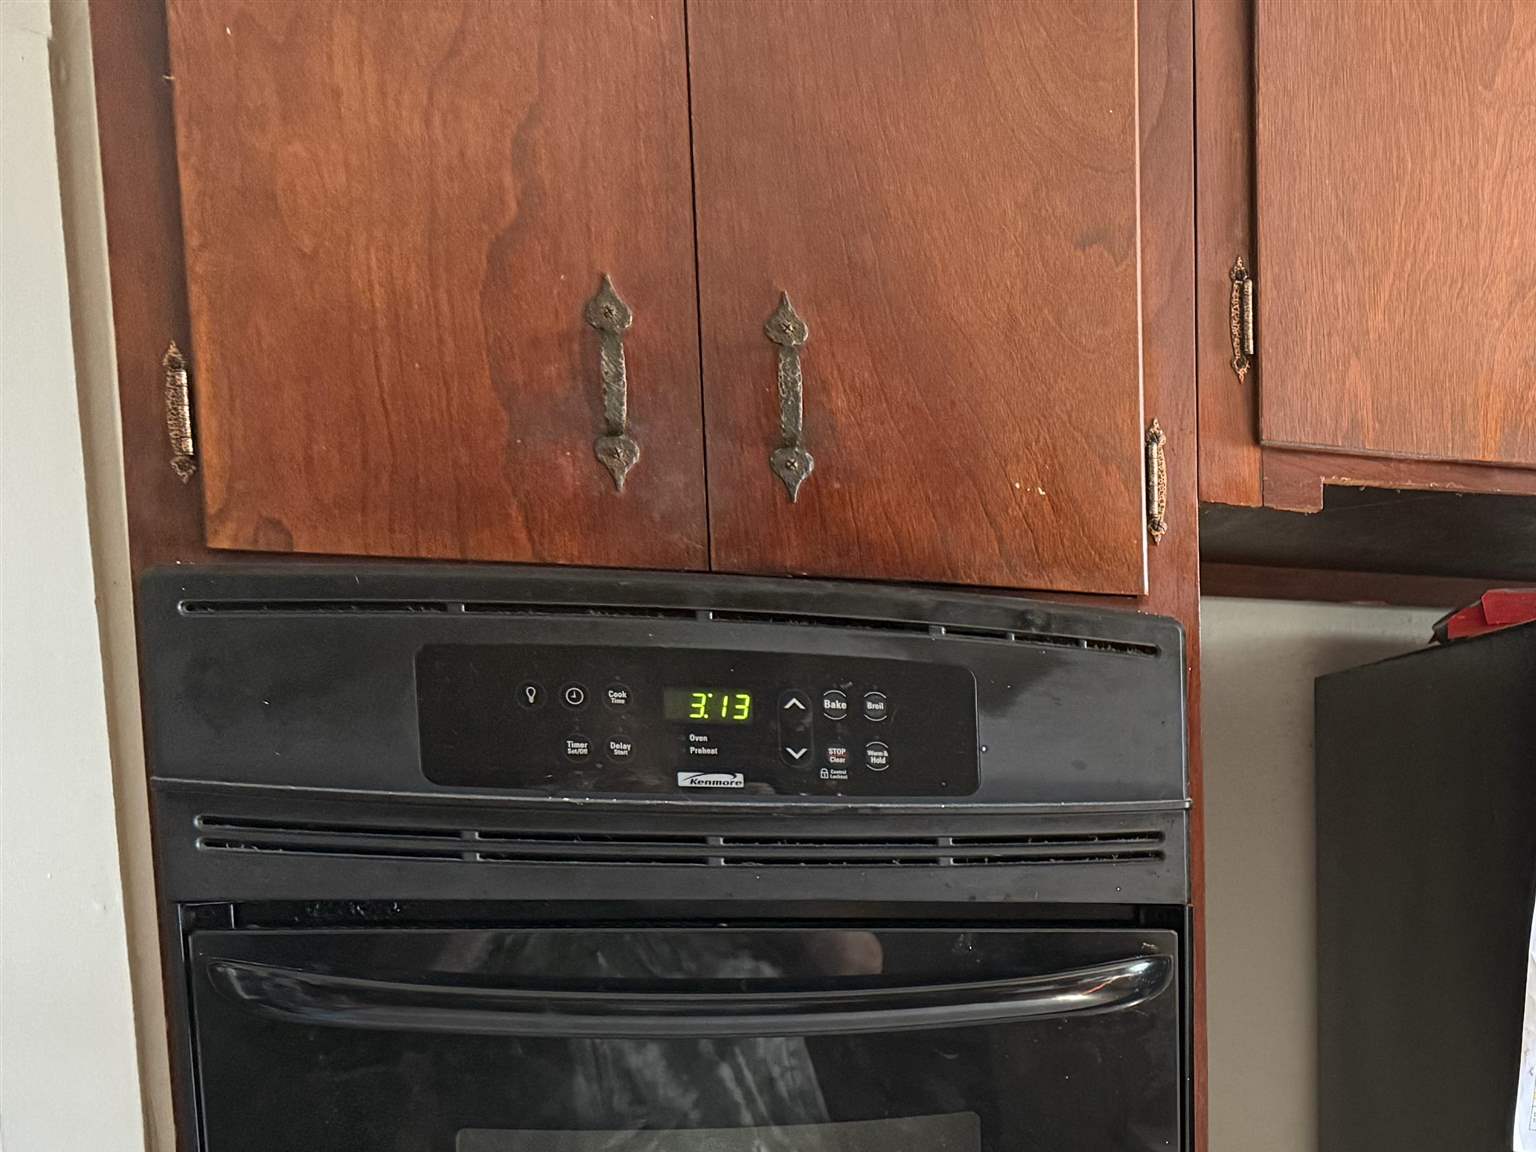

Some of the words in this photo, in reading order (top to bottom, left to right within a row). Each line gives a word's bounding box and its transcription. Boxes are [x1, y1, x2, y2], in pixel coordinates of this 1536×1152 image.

[608, 690, 627, 699] Cook
[824, 700, 847, 709] Bake
[866, 702, 884, 710] Broil
[689, 734, 708, 742] Oven
[567, 741, 588, 749] Timer
[610, 742, 631, 751] Delay
[690, 747, 718, 755] Preheat
[689, 777, 743, 786] Kenmore
